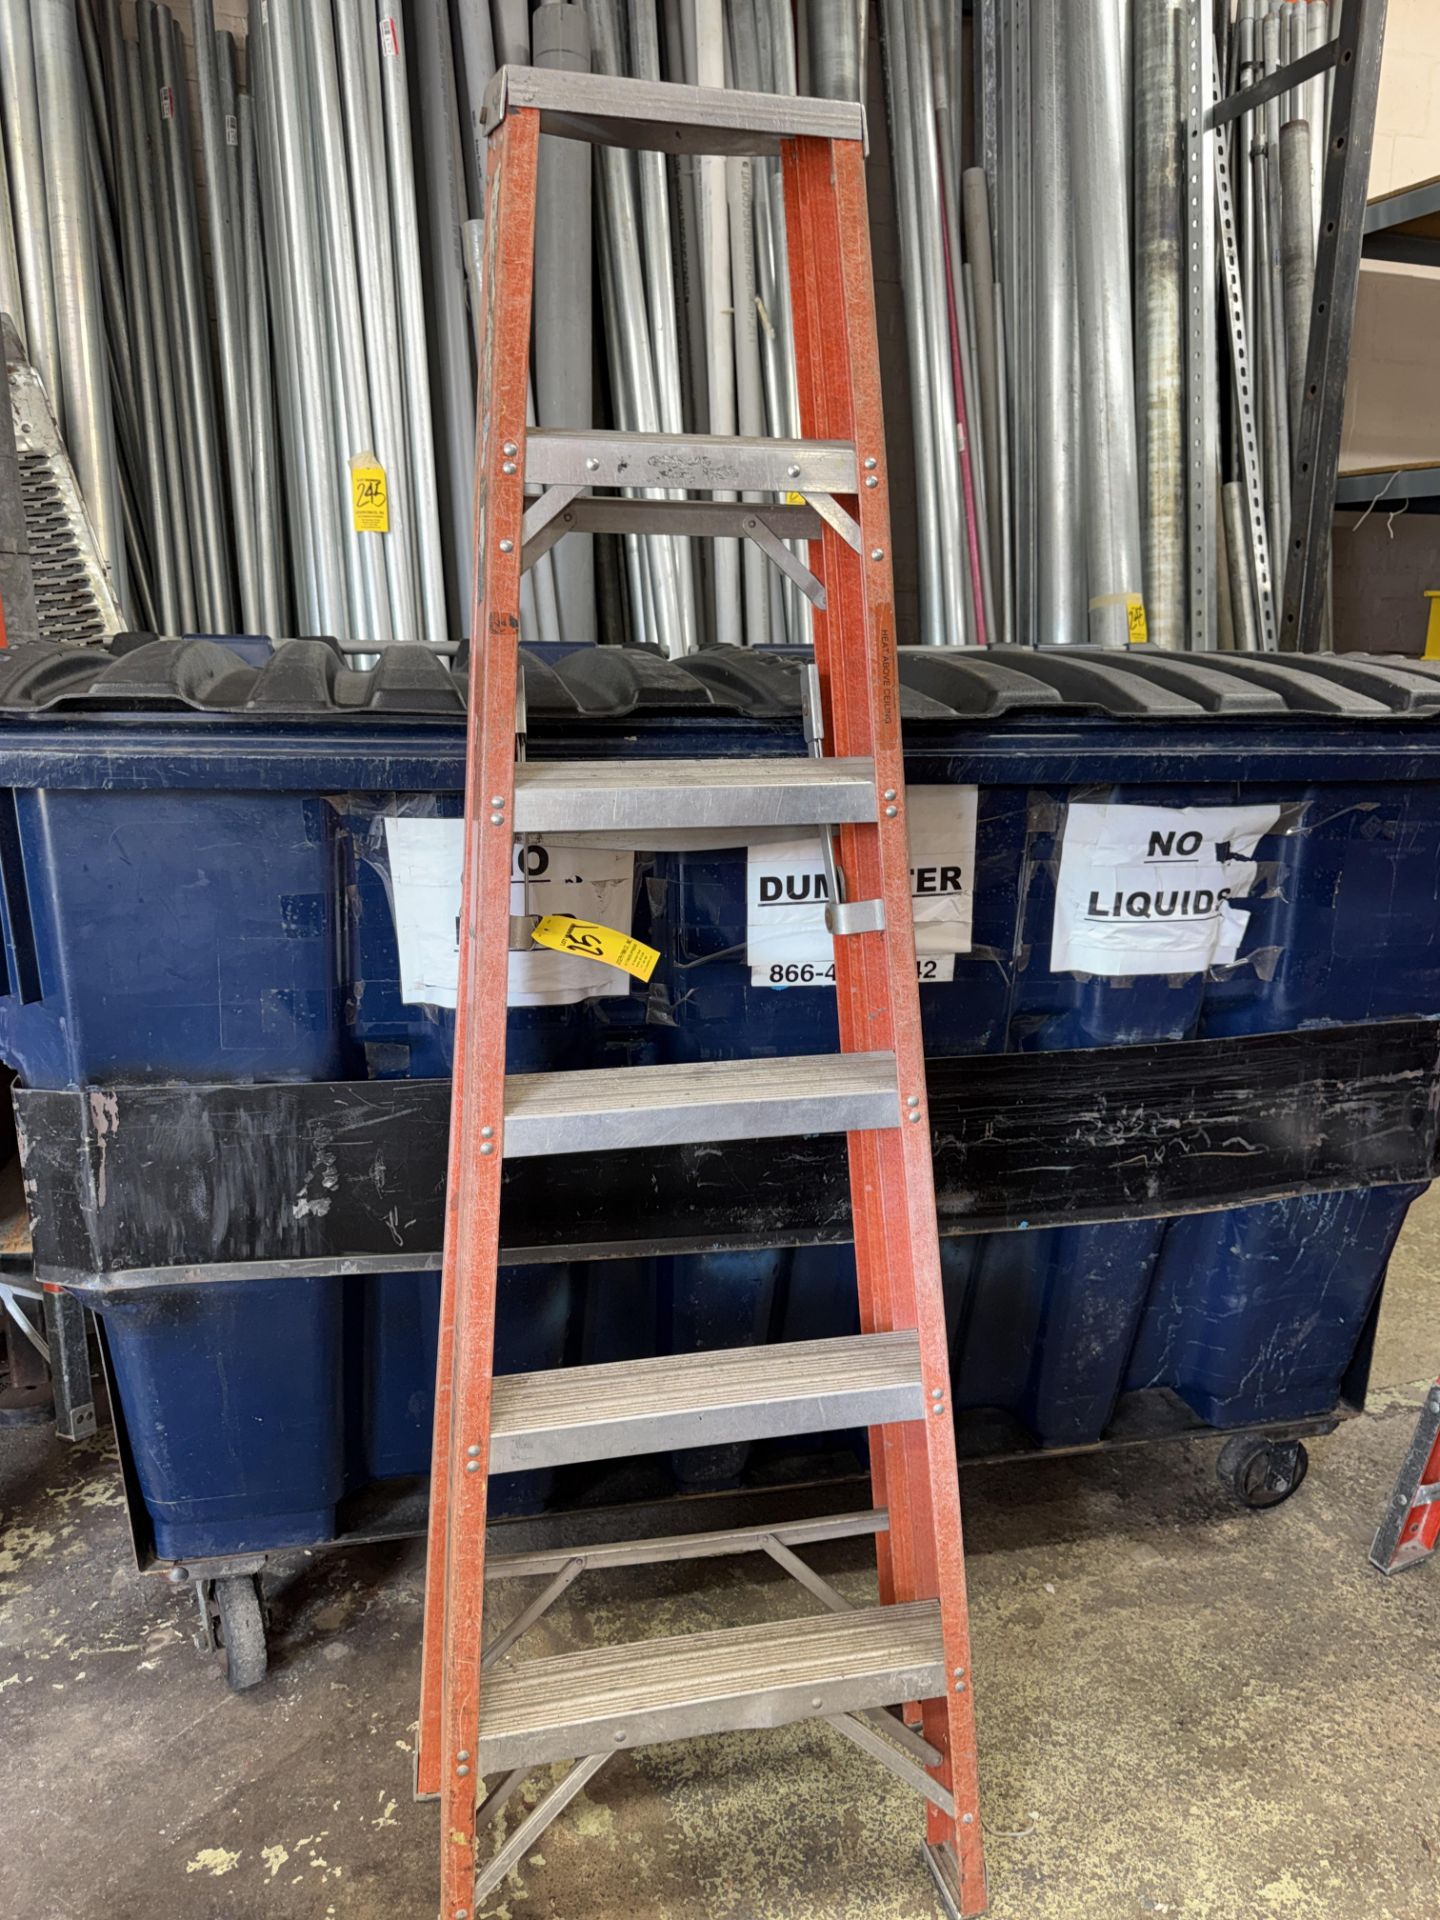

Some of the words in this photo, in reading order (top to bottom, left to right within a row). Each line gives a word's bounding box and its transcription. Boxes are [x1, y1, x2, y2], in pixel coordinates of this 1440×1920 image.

[881, 629, 889, 653] HEAT
[882, 656, 891, 686] ABOVE
[1147, 830, 1203, 857] NO
